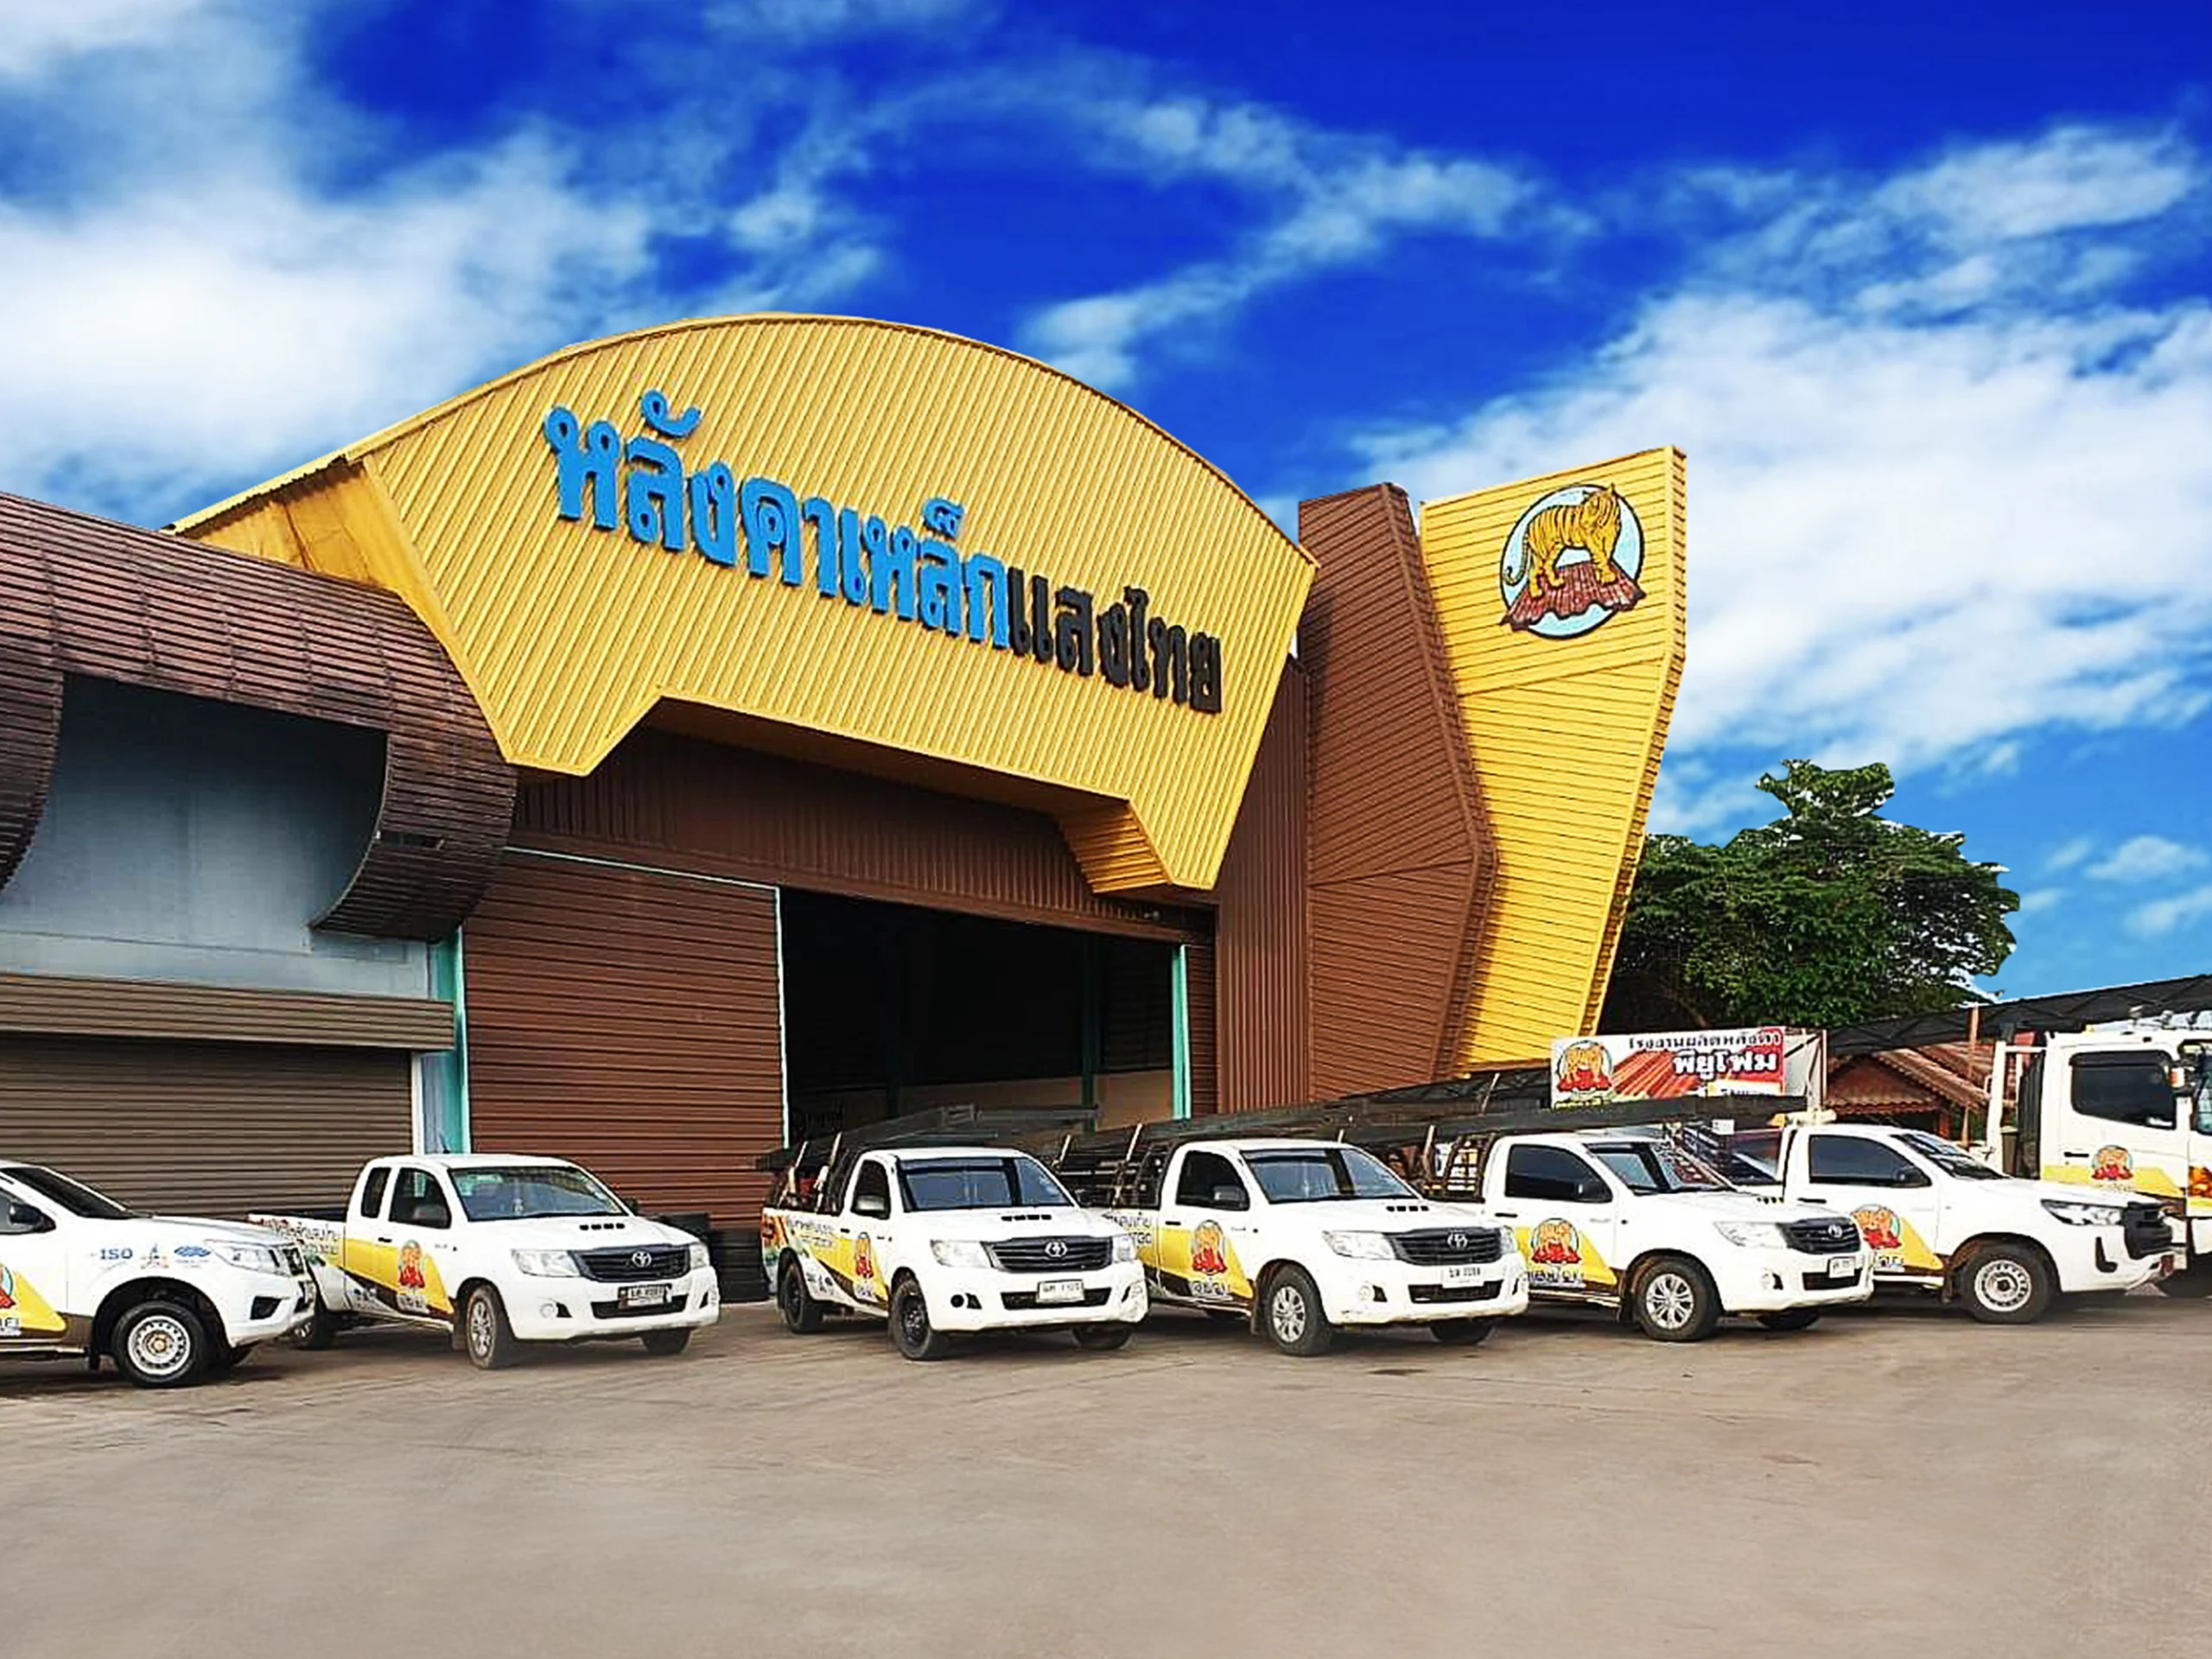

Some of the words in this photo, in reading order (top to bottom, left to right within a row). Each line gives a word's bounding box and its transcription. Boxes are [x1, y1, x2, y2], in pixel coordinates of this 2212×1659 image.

[1673, 1049, 1778, 1080] พียูโฟม
[99, 1248, 133, 1260] ISO
